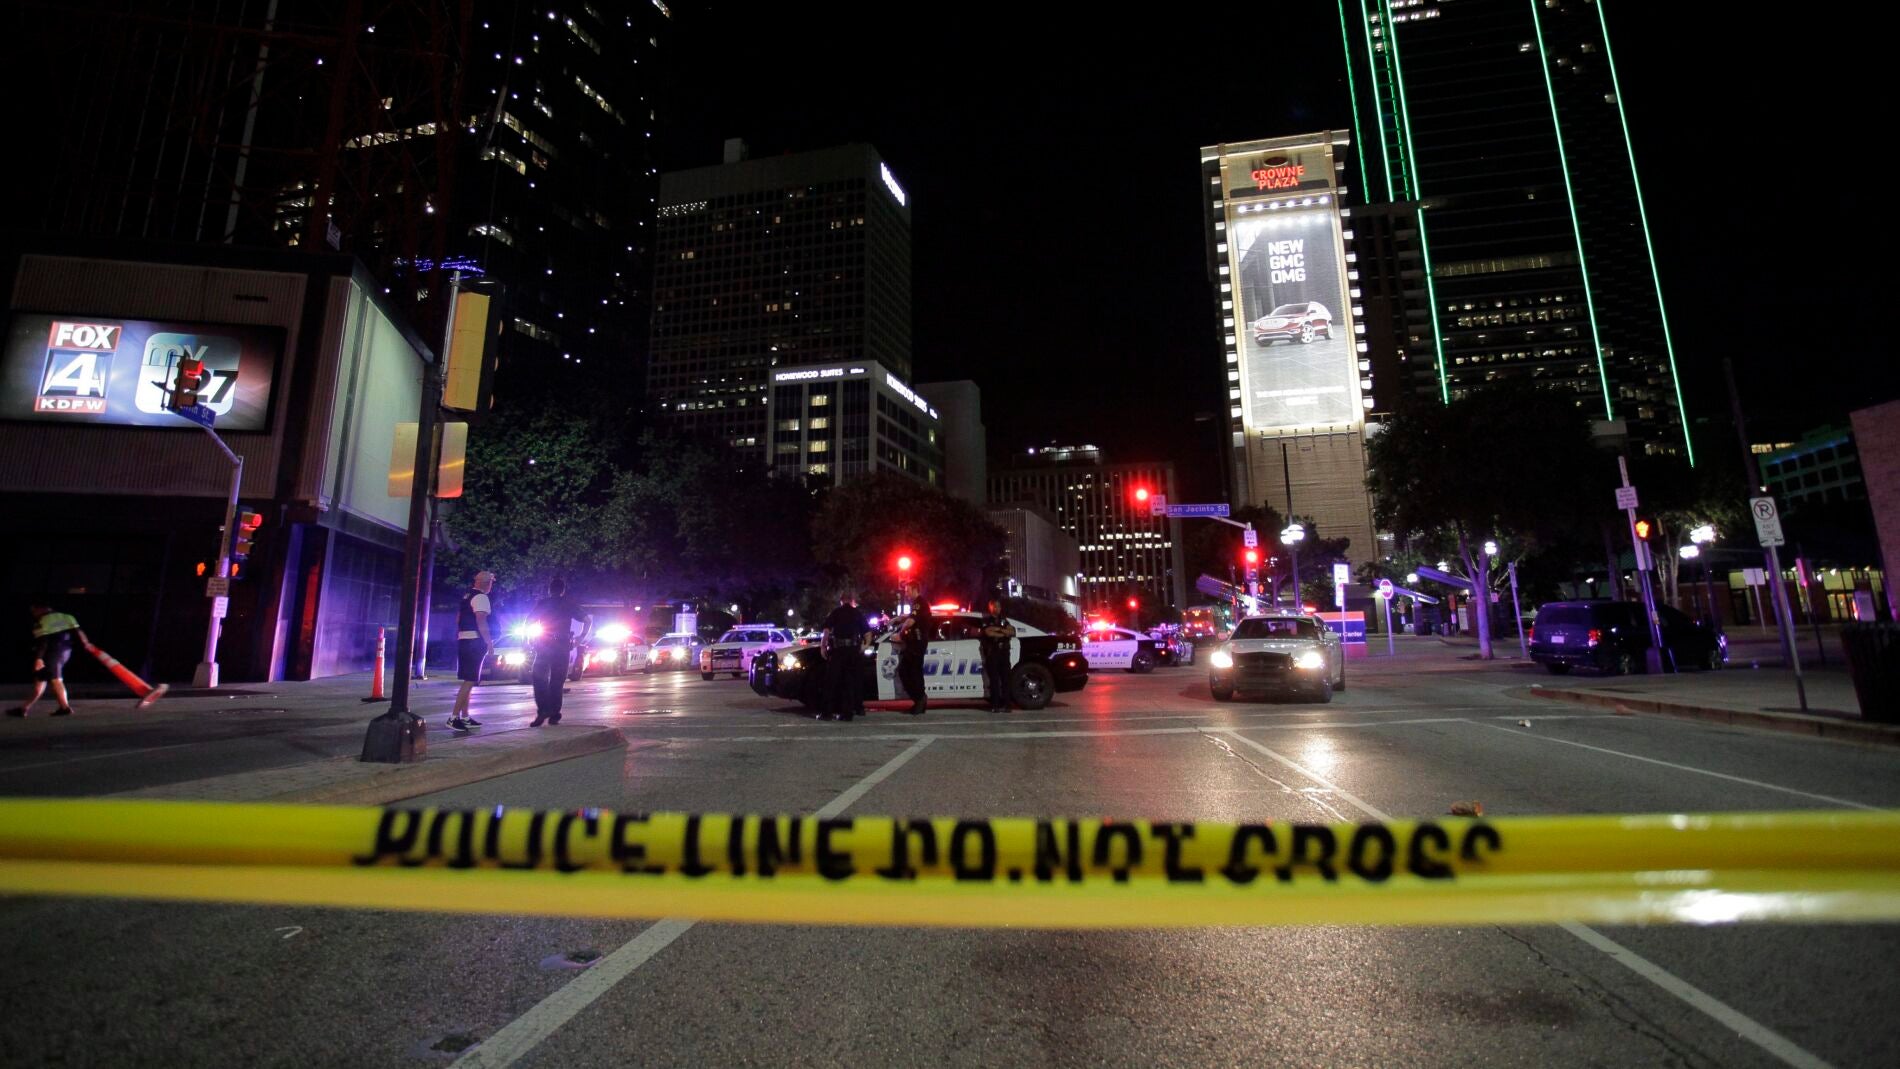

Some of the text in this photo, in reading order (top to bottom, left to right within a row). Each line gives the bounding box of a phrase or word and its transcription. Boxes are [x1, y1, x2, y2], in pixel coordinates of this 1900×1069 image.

[1252, 165, 1304, 181] CROWNE
[1259, 177, 1298, 190] PLAZA
[1268, 239, 1304, 255] NEW
[1270, 253, 1305, 269] GMC
[1271, 268, 1306, 284] OMG
[55, 323, 116, 349] FOX
[47, 353, 103, 396] 4
[41, 399, 103, 410] KDFW
[1186, 505, 1215, 513] Jacinto
[352, 809, 665, 875] POLICE
[677, 813, 860, 880] LINE
[1219, 822, 1503, 884] CROSS
